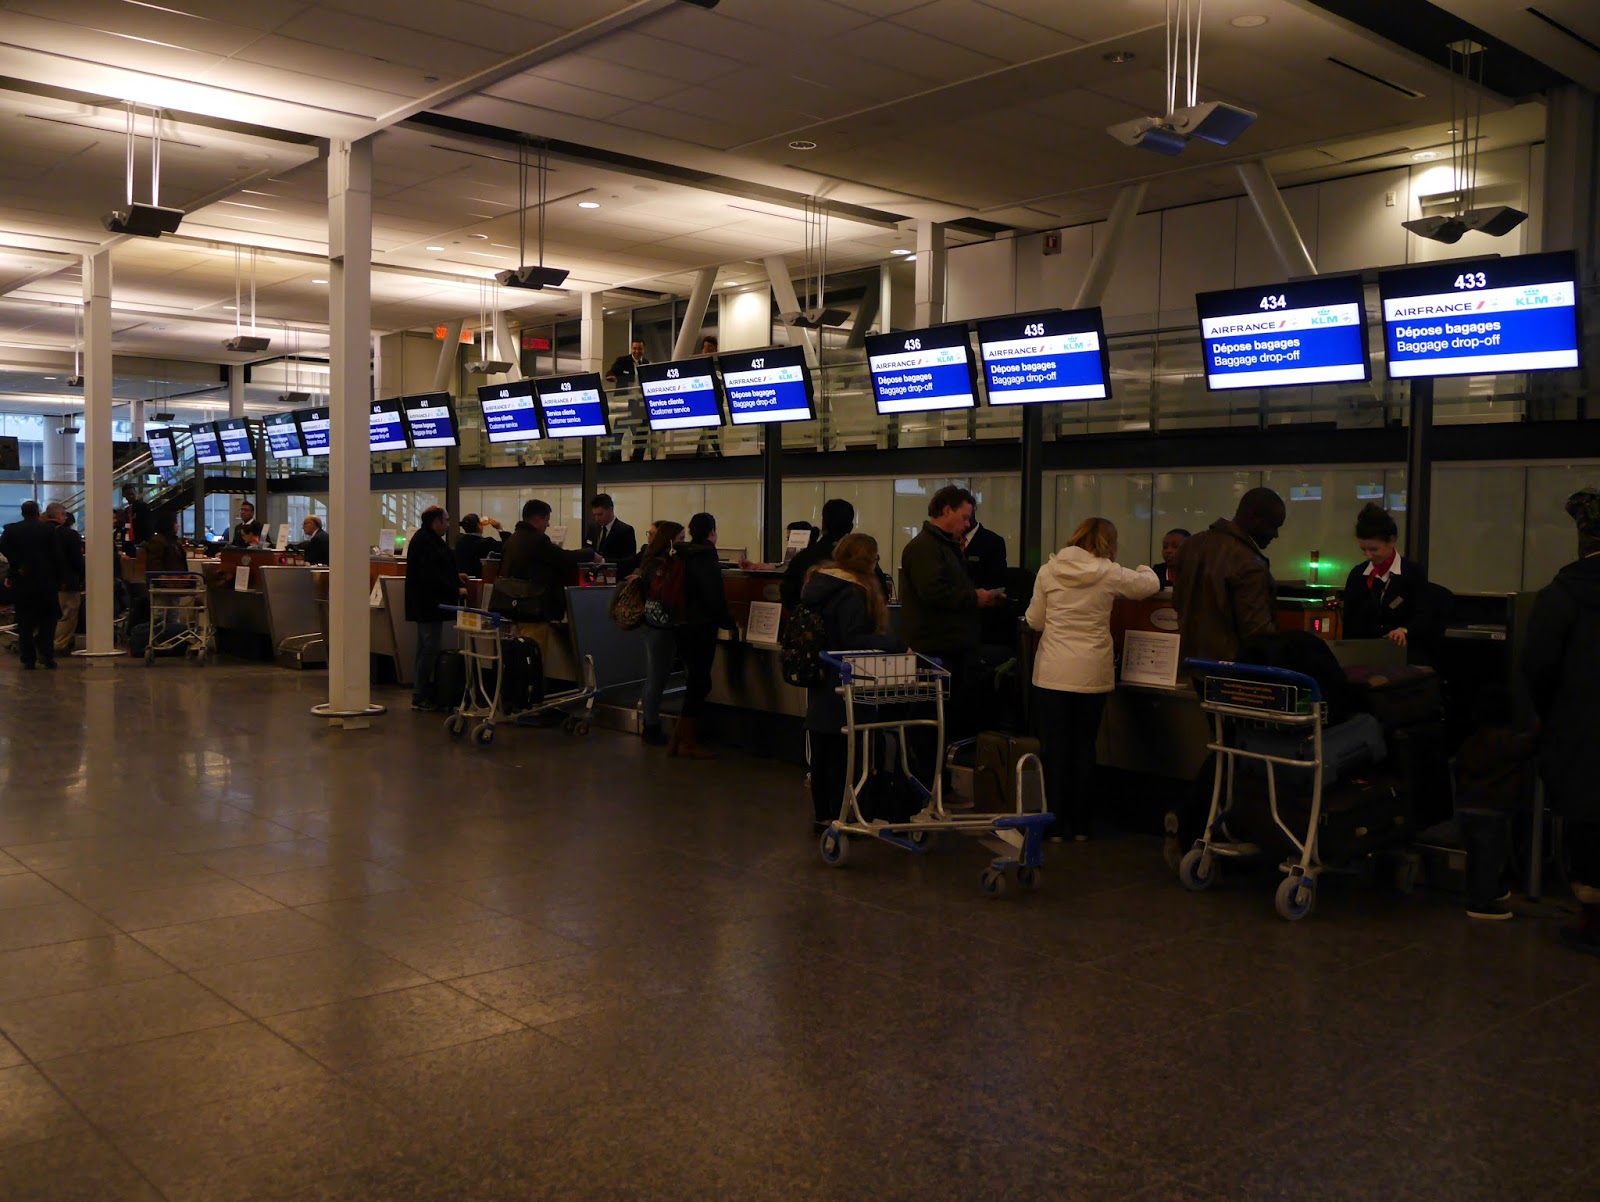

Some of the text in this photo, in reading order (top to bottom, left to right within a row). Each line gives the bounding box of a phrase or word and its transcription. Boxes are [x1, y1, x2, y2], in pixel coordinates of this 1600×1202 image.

[1454, 272, 1486, 290] 433
[1259, 295, 1287, 310] 434
[1515, 295, 1548, 306] KLM
[1394, 302, 1472, 317] AIRFRANCE
[1311, 315, 1338, 325] KLM
[1024, 323, 1044, 336] 435
[1210, 322, 1276, 334] AIRFRANCE
[1396, 320, 1501, 340] Dépose bagages
[904, 338, 921, 350] 436
[1063, 342, 1084, 350] KLM
[1212, 336, 1300, 355] Dépose bagages
[1397, 334, 1500, 354] Baggage drop-off
[989, 346, 1037, 357] AIRFRANCE
[751, 358, 764, 368] 437
[1214, 350, 1300, 367] Baggage drop-off
[876, 360, 916, 369] AIRFRANCE
[991, 361, 1056, 375] Dépose bagages
[667, 369, 679, 378] 438
[878, 372, 932, 386] Dépose bagages
[992, 372, 1057, 386] Baggage drop-off
[561, 382, 571, 391] 439
[729, 377, 762, 385] AIRFRANCE
[647, 386, 676, 394] AIRFRANCE
[731, 388, 776, 399] Dépose bagages
[879, 383, 933, 396] Baggage drop-off
[649, 399, 667, 407] Service
[733, 398, 777, 408] Baggage drop-off
[651, 406, 690, 416] Customer service
